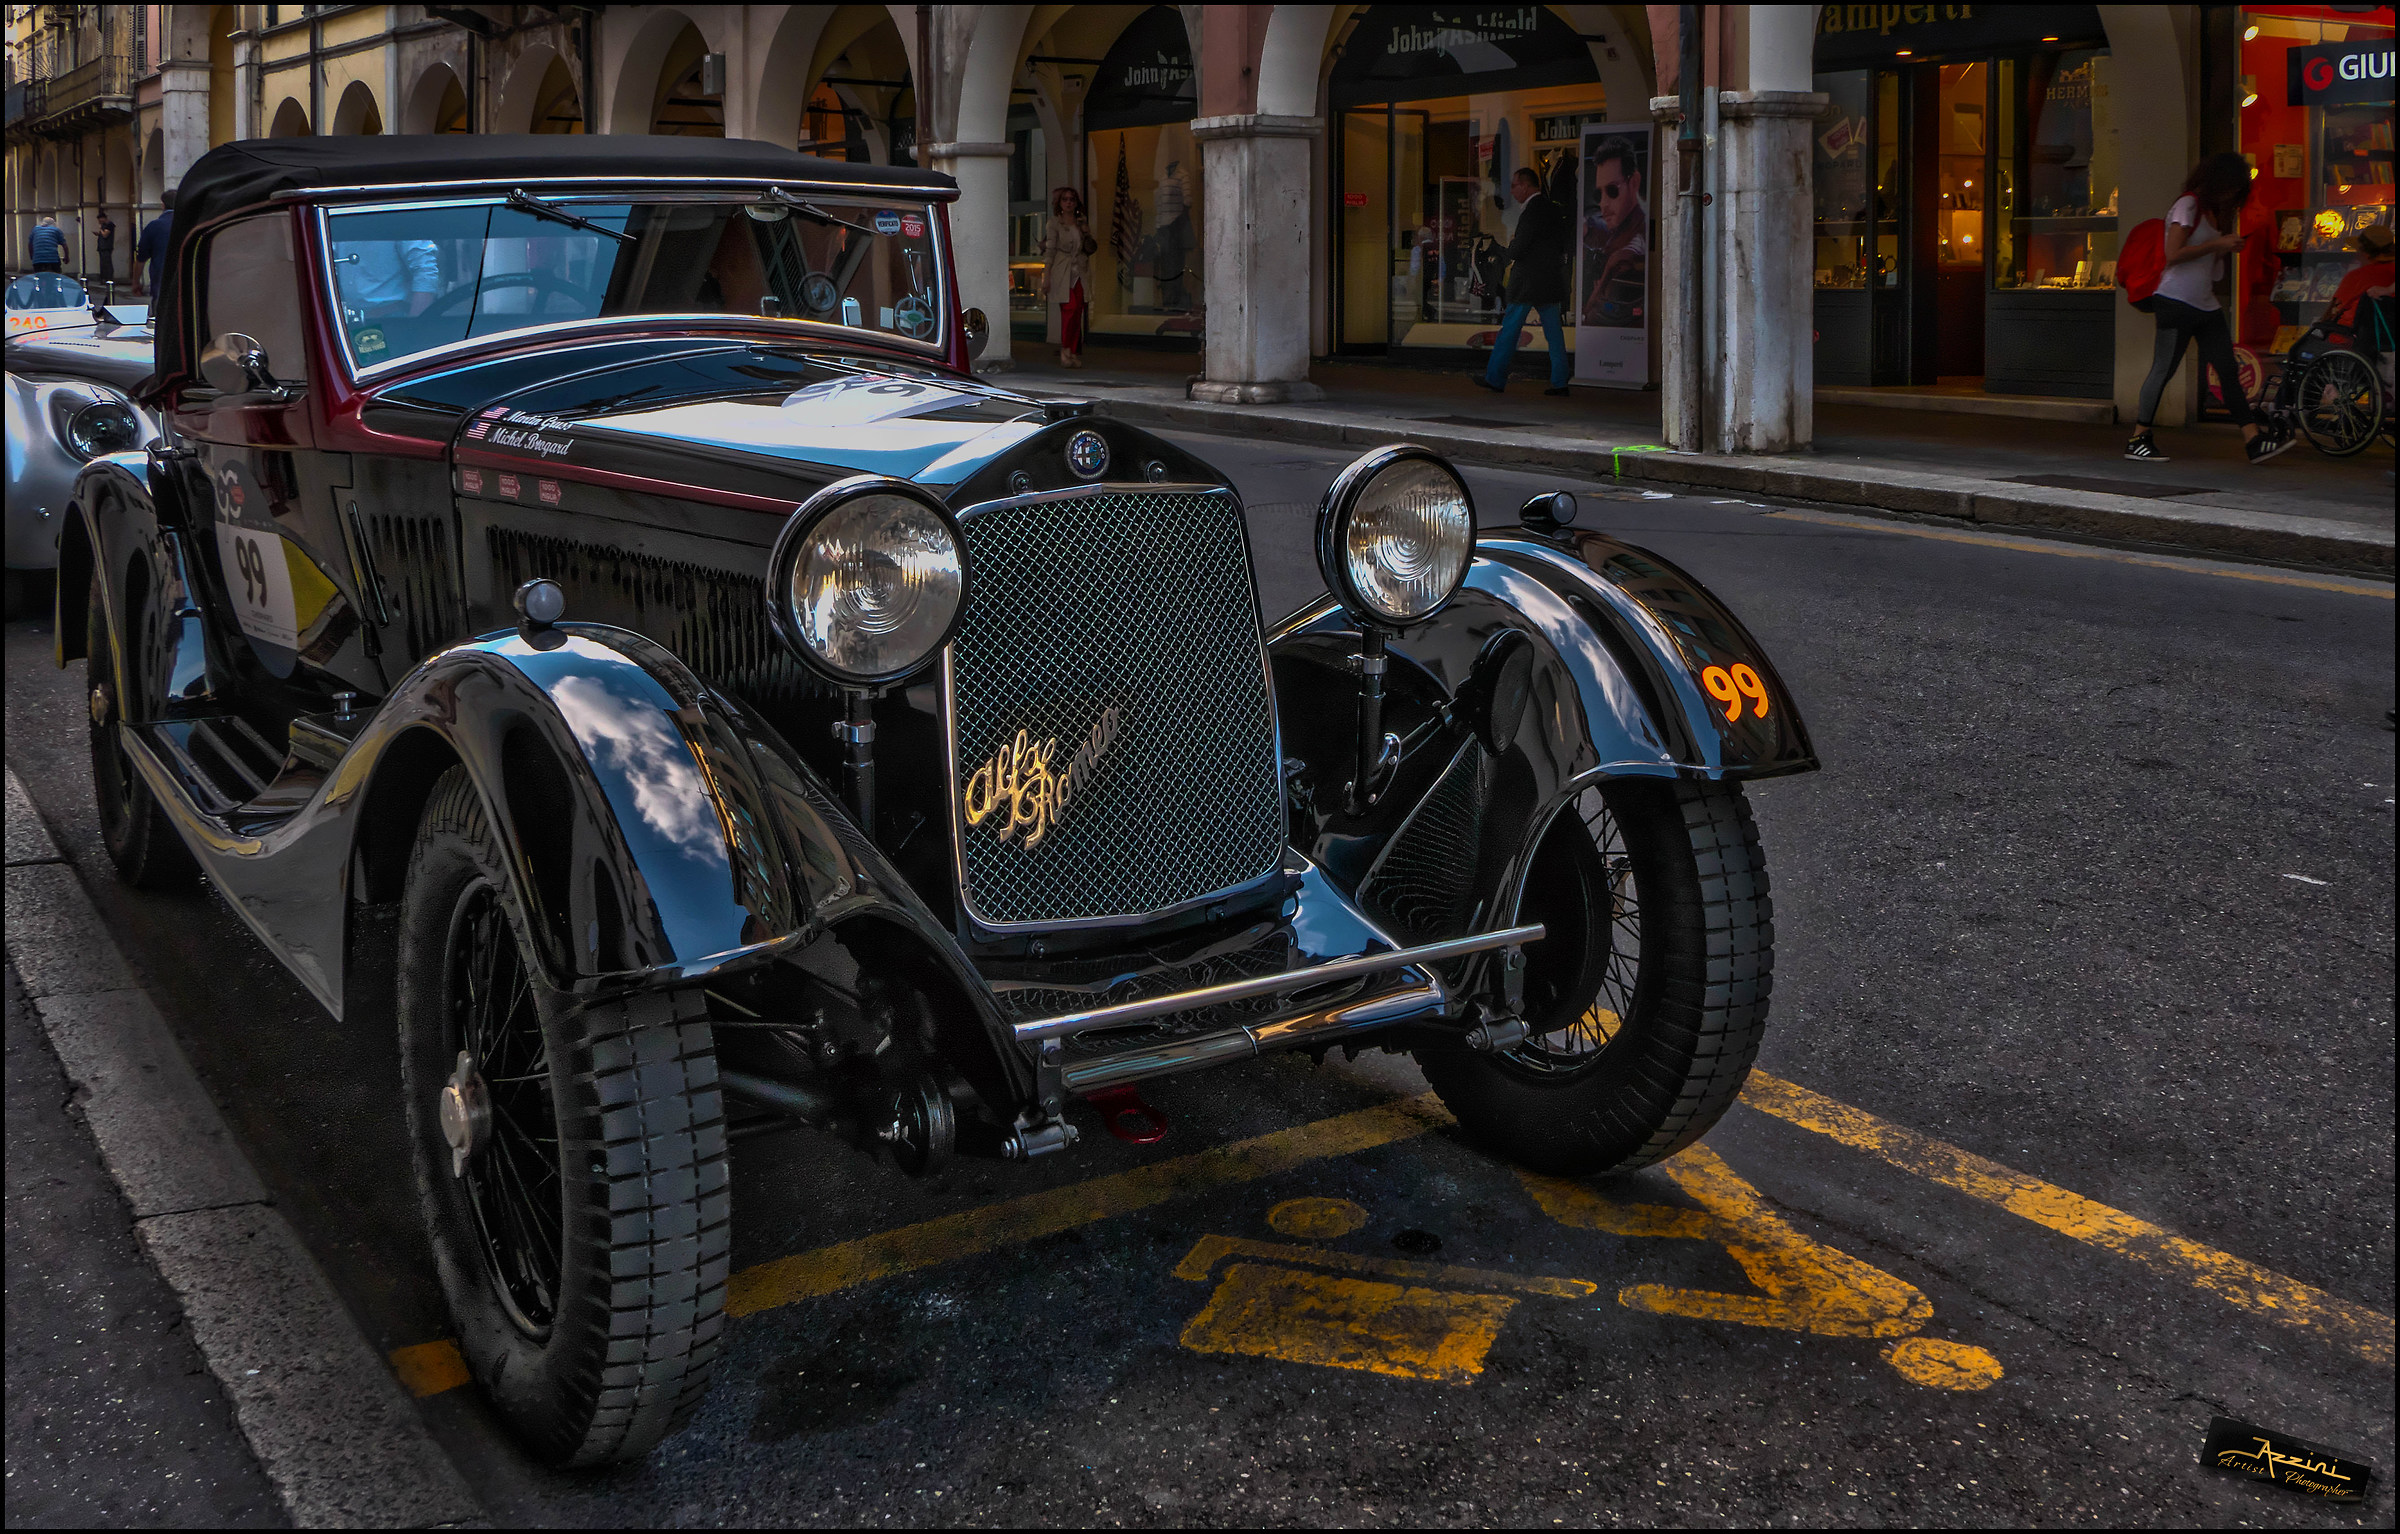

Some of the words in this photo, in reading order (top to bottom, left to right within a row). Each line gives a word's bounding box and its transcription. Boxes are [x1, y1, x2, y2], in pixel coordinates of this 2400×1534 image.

[1387, 25, 1434, 54] John
[1124, 66, 1158, 87] John
[1539, 119, 1576, 141] John
[905, 223, 921, 232] 2015
[9, 316, 48, 331] 240
[488, 427, 529, 449] Michel
[524, 433, 575, 458] Brogard
[235, 535, 267, 608] 99
[1702, 663, 1769, 722] 99
[1016, 706, 1121, 851] Romeo
